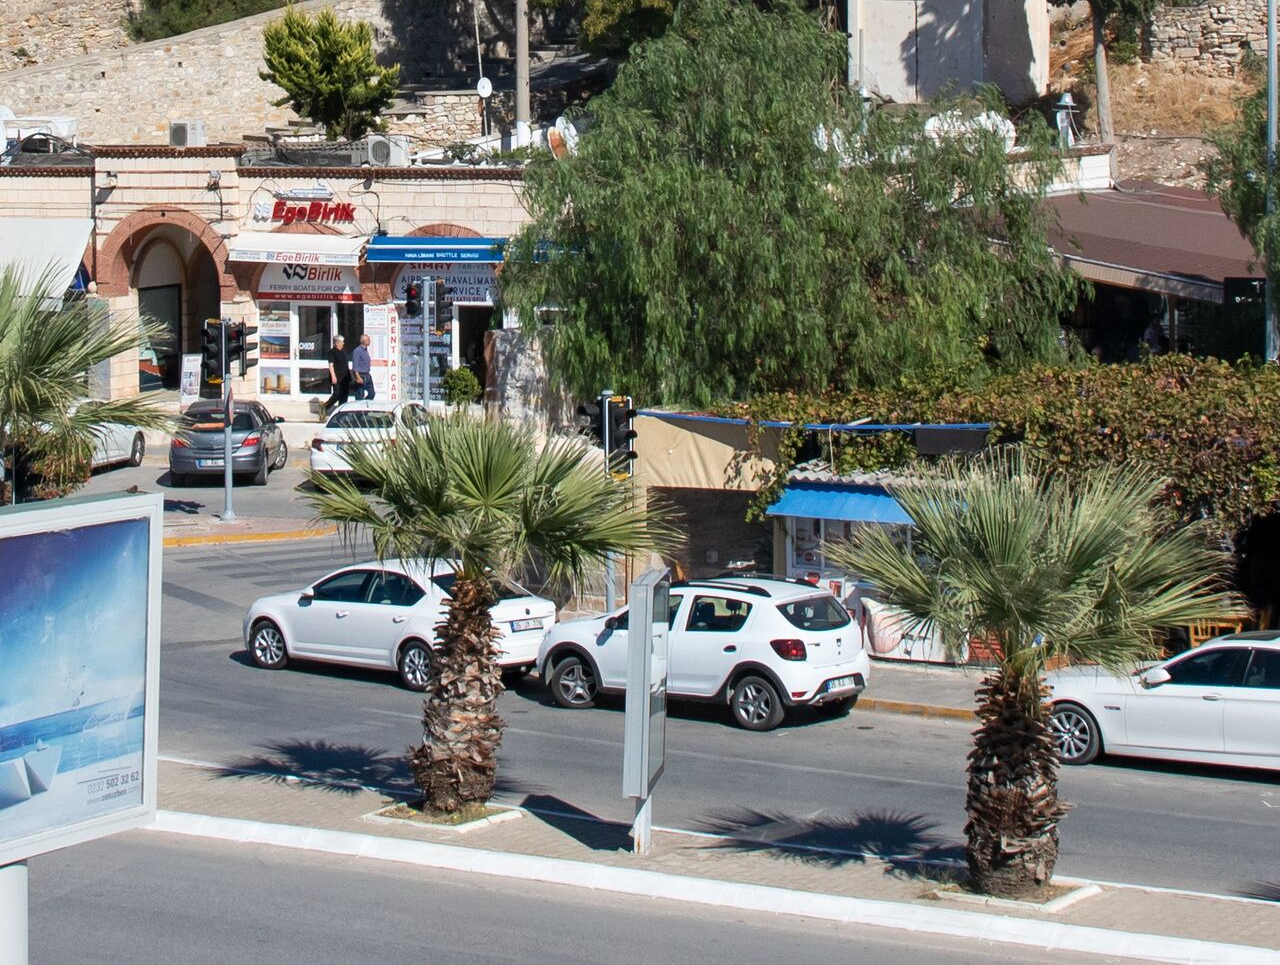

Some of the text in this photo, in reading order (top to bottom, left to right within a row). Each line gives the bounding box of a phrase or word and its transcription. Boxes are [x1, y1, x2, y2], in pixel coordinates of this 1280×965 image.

[307, 265, 342, 281] Birlik
[269, 283, 293, 292] FERRY
[294, 283, 316, 292] BOATS
[317, 284, 332, 292] FOR
[390, 316, 398, 354] RENT
[299, 341, 315, 350] CHIOS
[390, 359, 397, 367] A
[390, 373, 398, 401] CAR
[106, 776, 120, 790] 502
[120, 773, 130, 785] 32
[130, 770, 140, 783] 62
